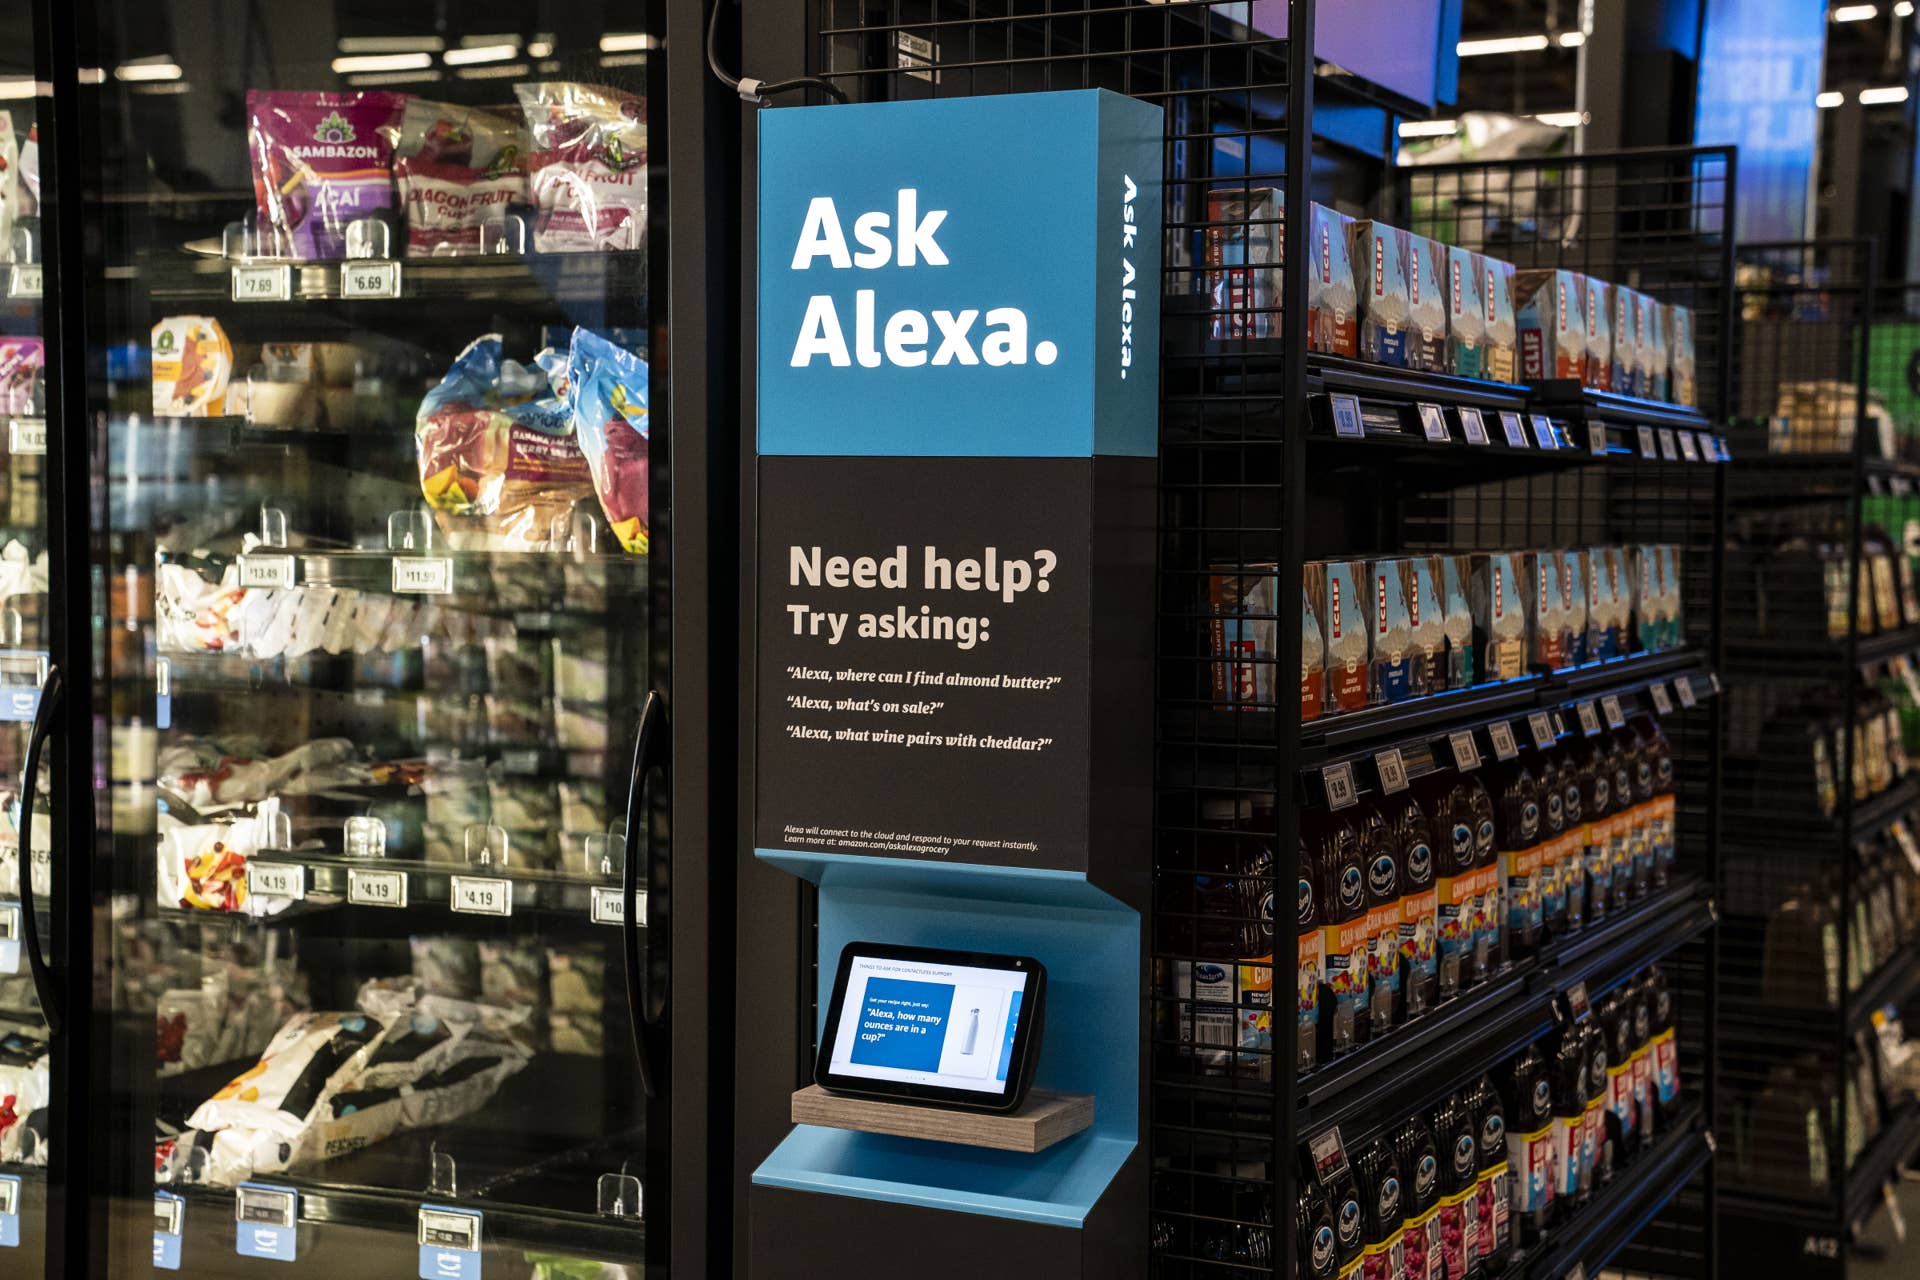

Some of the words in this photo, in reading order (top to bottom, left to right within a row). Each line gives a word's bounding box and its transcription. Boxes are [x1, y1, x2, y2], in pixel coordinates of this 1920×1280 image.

[292, 146, 378, 159] SAMBAZON
[1123, 174, 1138, 249] Ask
[791, 188, 950, 270] Ask
[246, 279, 273, 293] $7.69
[354, 276, 382, 291] $6.69
[790, 290, 1058, 367] Alexa.
[1120, 257, 1138, 380] Alexa.
[1524, 332, 1540, 370] CLIF
[789, 546, 907, 588] Need
[925, 546, 1057, 603] help?
[786, 604, 849, 645] Try
[858, 605, 991, 650] asking:
[787, 666, 833, 682] “Alexa,
[836, 668, 876, 683] where
[878, 671, 903, 683] can
[905, 671, 912, 684] I
[913, 670, 944, 687] find
[945, 673, 1000, 688] almond
[1002, 675, 1061, 690] butter?”
[787, 695, 833, 712] “Alexa,
[836, 698, 880, 712] what’s
[882, 701, 900, 713] on
[902, 701, 945, 715] sale?”
[786, 725, 832, 742] “Alexa,
[835, 728, 870, 742] what
[872, 729, 905, 744] wine
[906, 731, 943, 747] pairs
[945, 732, 977, 748] with
[979, 735, 1053, 751] cheddar?”
[784, 825, 804, 834] Alexa
[805, 826, 819, 835] will
[820, 828, 849, 837] connect
[850, 830, 858, 838] to
[860, 830, 872, 839] the
[873, 831, 894, 840] cloud
[895, 832, 911, 842] and
[912, 834, 942, 844] respond
[943, 836, 952, 844] to
[953, 838, 971, 847] your
[972, 839, 1001, 848] request
[1002, 840, 1039, 852] instantly.
[784, 834, 804, 843] Learn
[806, 837, 825, 845] more
[838, 839, 950, 855] amazon.com/askalexagrocery
[260, 875, 286, 890] $4.19
[361, 882, 389, 897] $4.19
[465, 890, 493, 906] $4.19
[867, 1007, 895, 1020] "Alexa,
[897, 1011, 916, 1021] how
[918, 1014, 942, 1026] many
[861, 1033, 886, 1043] cup?"
[864, 1021, 893, 1031] ounces
[895, 1024, 909, 1033] are
[910, 1024, 919, 1034] in
